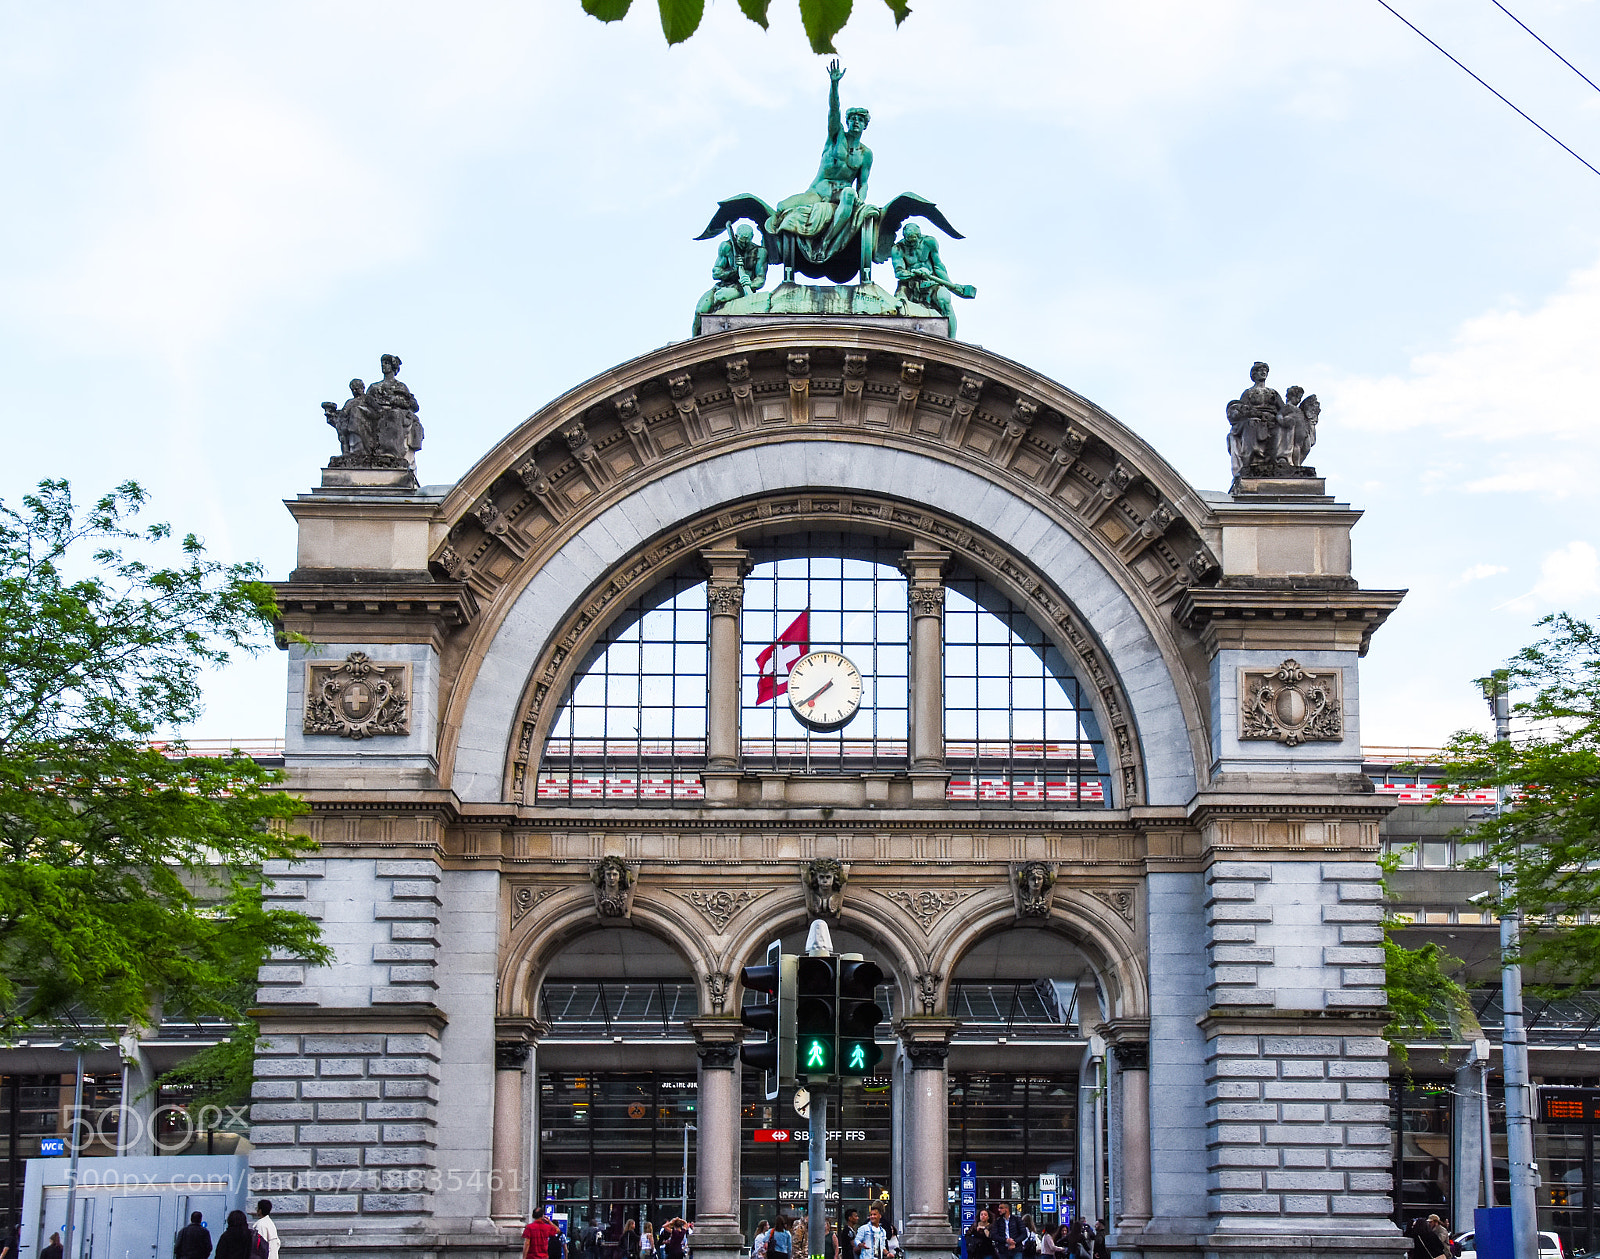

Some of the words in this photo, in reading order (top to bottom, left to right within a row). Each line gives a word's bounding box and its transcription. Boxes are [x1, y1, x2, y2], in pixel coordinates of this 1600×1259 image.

[794, 1131, 810, 1141] SB
[845, 1131, 866, 1141] FFS
[41, 1142, 57, 1151] WC
[1041, 1178, 1055, 1186] TAXI
